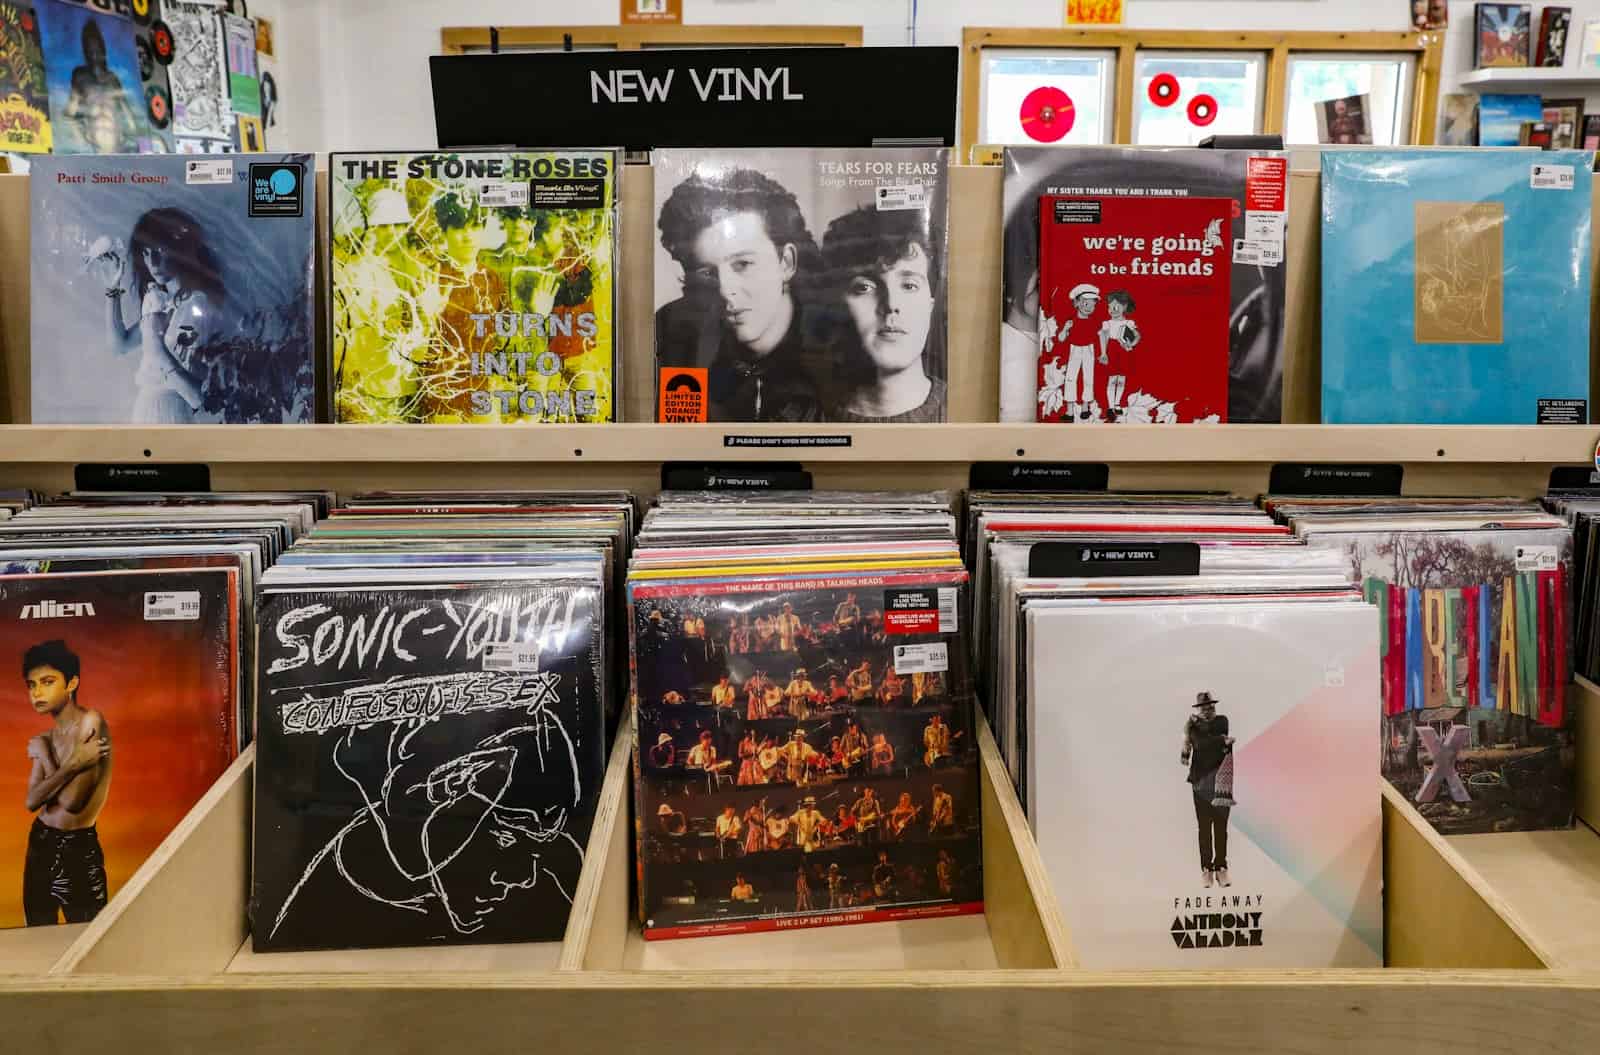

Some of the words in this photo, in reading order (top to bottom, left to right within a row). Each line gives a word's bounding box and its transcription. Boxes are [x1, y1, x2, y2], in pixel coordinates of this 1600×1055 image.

[590, 69, 675, 103] NEW
[689, 67, 803, 101] VINYL
[342, 160, 398, 179] THE
[407, 159, 504, 179] STONE
[513, 158, 608, 177] ROSES
[819, 162, 861, 175] TEARS
[865, 162, 893, 175] FOR
[898, 162, 938, 175] FEARS
[57, 172, 86, 184] Patti
[91, 171, 125, 184] Smith
[131, 172, 169, 186] Group
[254, 178, 269, 188] We
[849, 177, 873, 185] From
[254, 186, 270, 194] are
[254, 188, 276, 202] vinyl
[1086, 187, 1113, 195] THANKS
[1150, 188, 1173, 196] THANK
[1083, 234, 1145, 250] we're
[1151, 234, 1215, 256] going
[1091, 263, 1106, 274] to
[1110, 262, 1127, 274] be
[1130, 258, 1213, 275] friends
[469, 312, 597, 337] TURNS
[470, 352, 561, 376] INTO
[470, 390, 597, 415] STONE
[665, 407, 701, 415] ORANGE
[665, 415, 699, 423] VINYL
[1093, 551, 1100, 559] V
[1105, 551, 1126, 559] NEW
[1127, 551, 1155, 559] VINYL
[742, 584, 765, 592] NAME
[777, 582, 793, 590] THIS
[827, 579, 857, 587] TALKING
[859, 577, 883, 585] HEADS
[487, 673, 561, 714] SEX
[1415, 725, 1472, 801] X
[1174, 896, 1213, 908] FADE
[1221, 895, 1263, 907] AWAY
[776, 919, 793, 927] LIVE
[1171, 912, 1263, 931] ANTHONY
